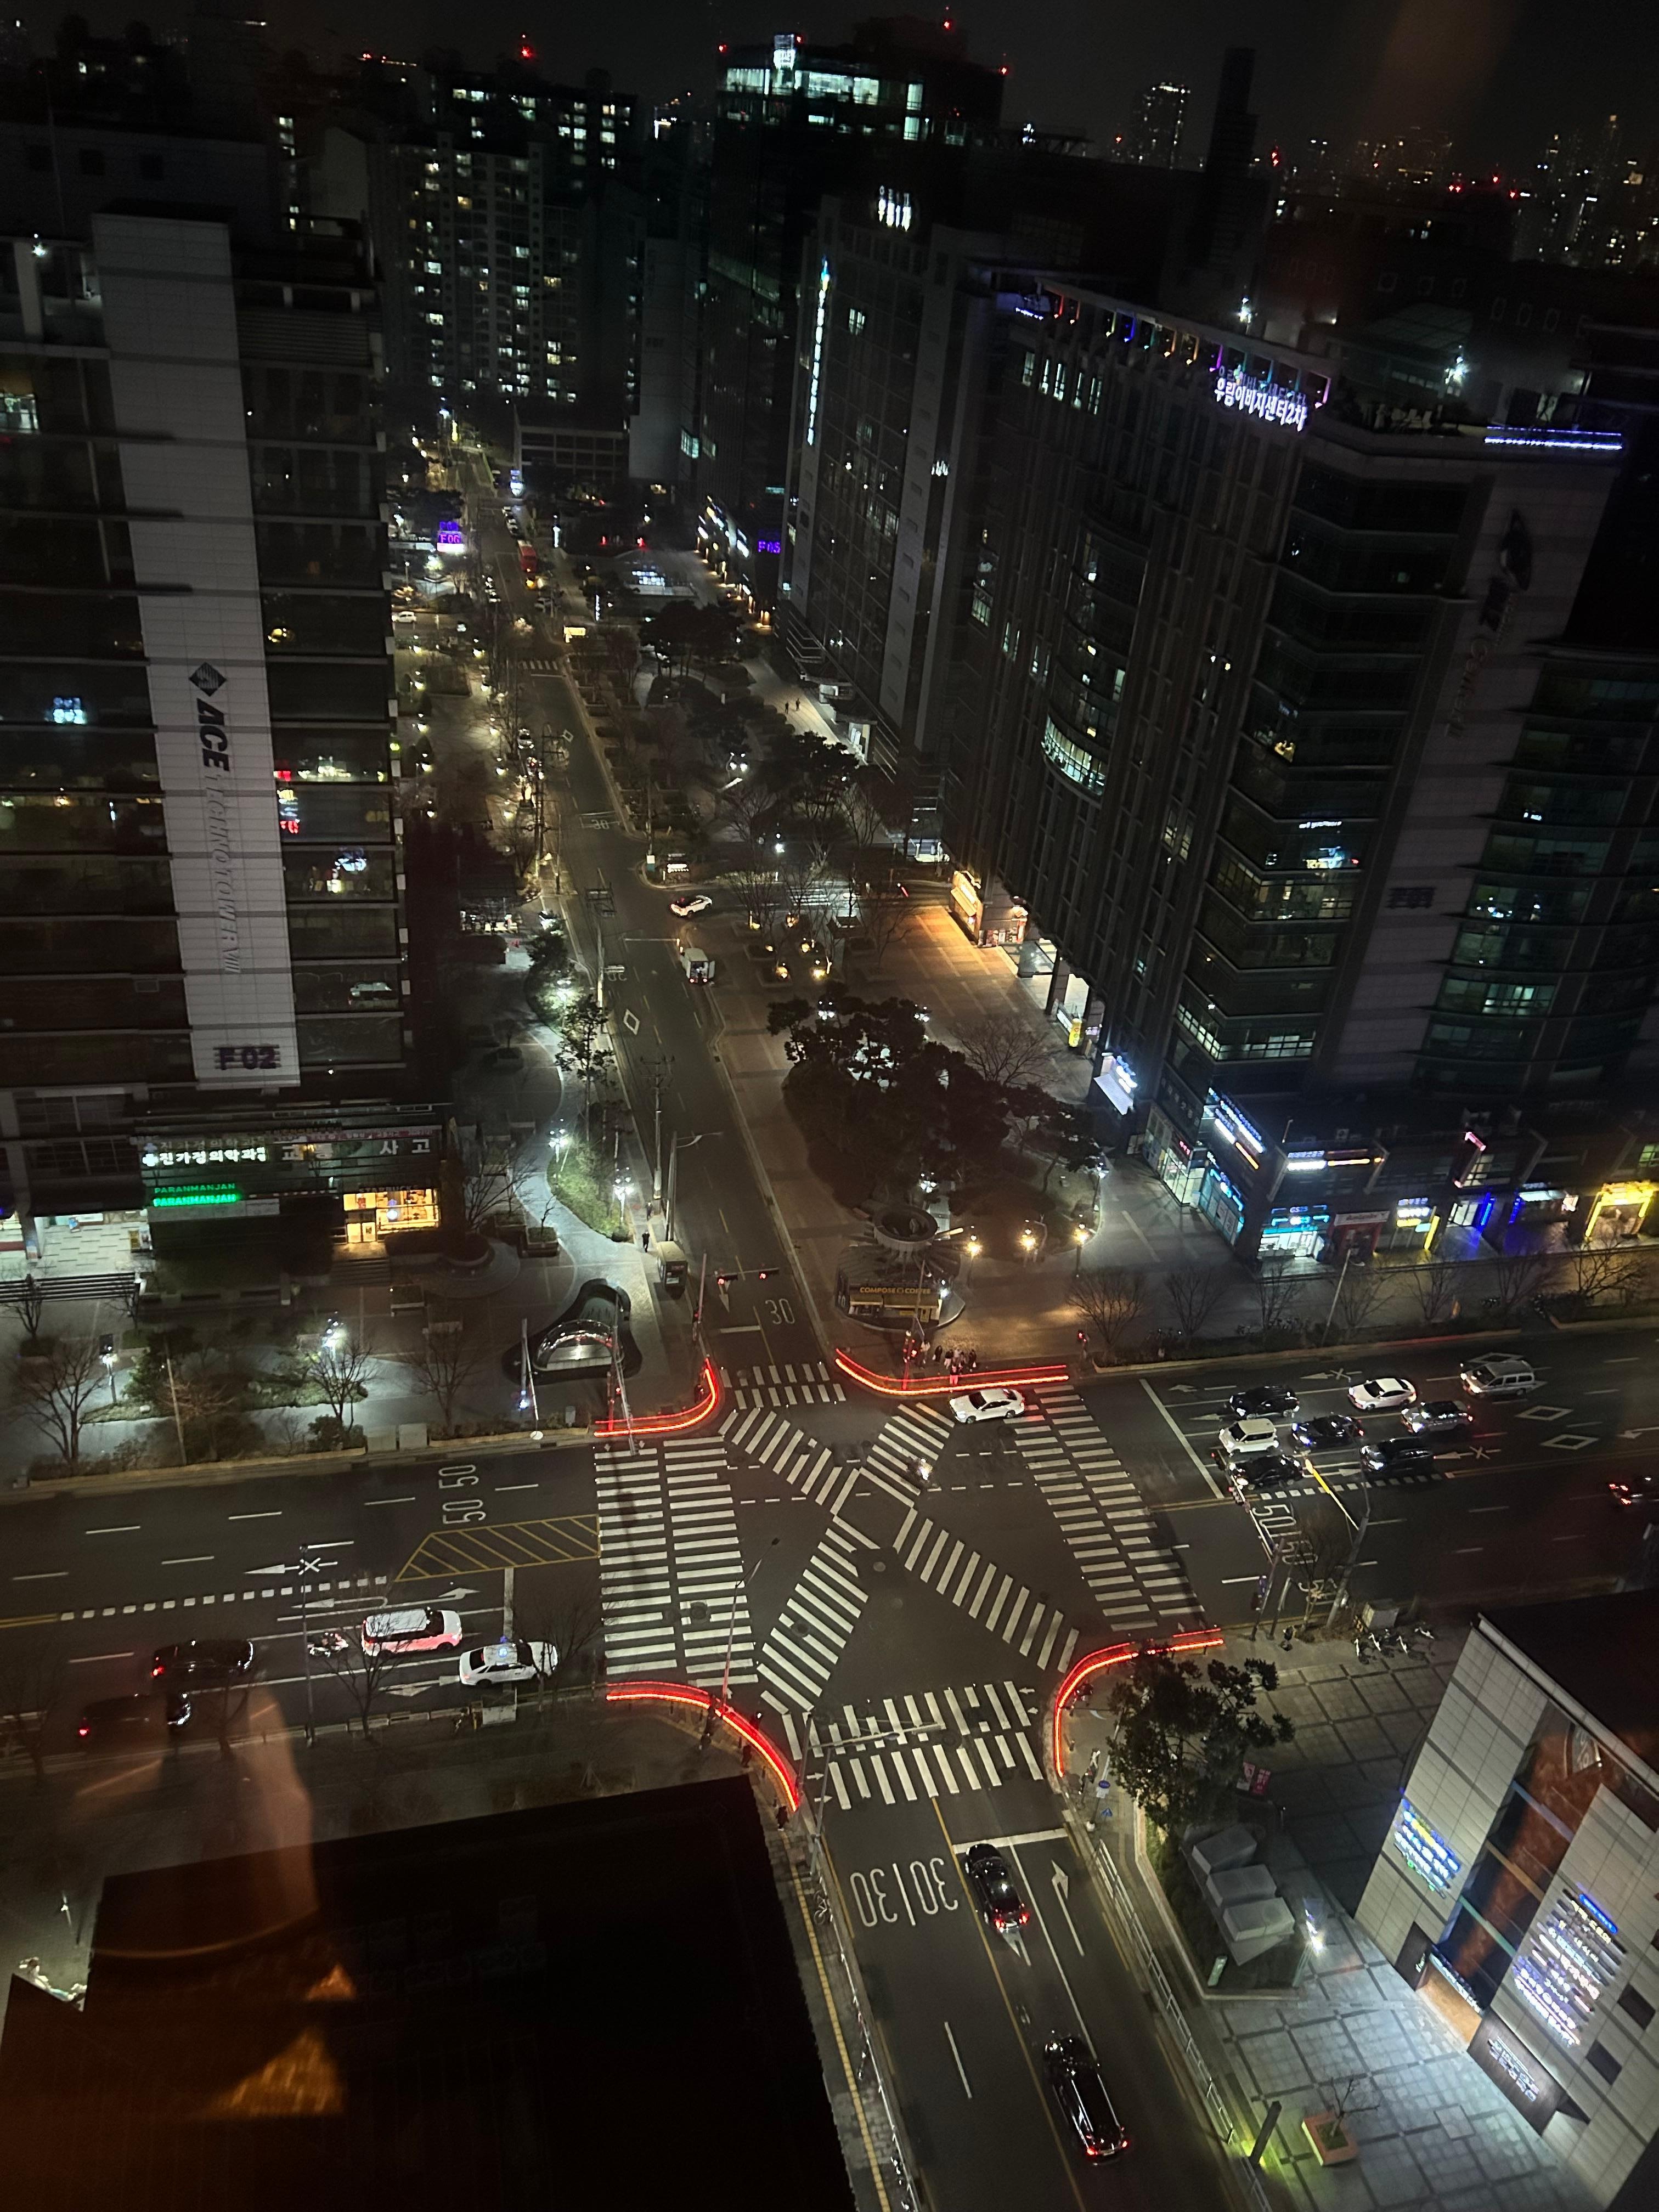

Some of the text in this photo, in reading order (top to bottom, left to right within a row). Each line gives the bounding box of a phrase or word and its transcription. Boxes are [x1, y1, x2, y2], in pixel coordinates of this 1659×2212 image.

[197, 698, 229, 771] ACE
[219, 1044, 277, 1070] F02
[153, 1194, 237, 1206] PARANMANJAN
[765, 1297, 795, 1324] 30
[438, 1464, 479, 1489] 50
[442, 1499, 487, 1524] 50
